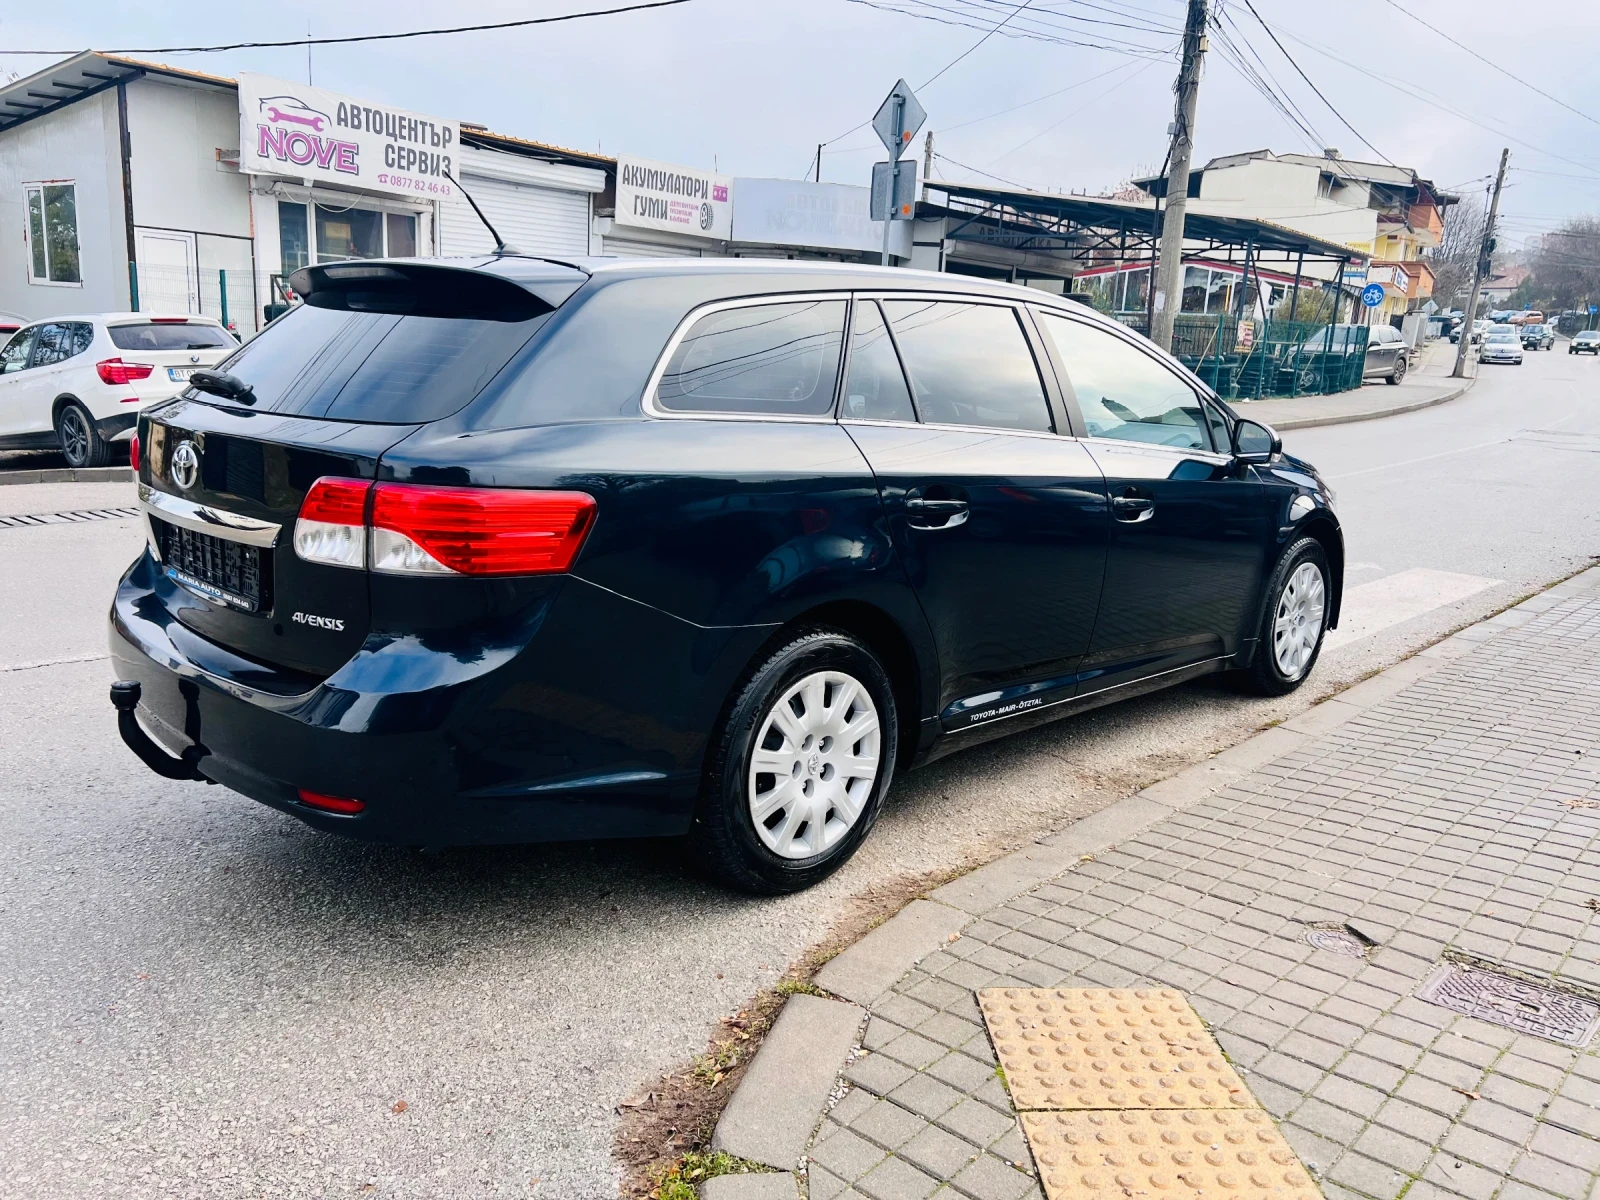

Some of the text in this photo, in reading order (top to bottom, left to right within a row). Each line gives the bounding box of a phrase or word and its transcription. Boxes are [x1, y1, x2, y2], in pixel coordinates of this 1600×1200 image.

[337, 101, 452, 149] АВТОЦЕНТЪР
[257, 124, 360, 176] NOVE
[384, 143, 452, 179] СЕРВИЗ
[390, 175, 451, 196] 0877 82 46 43
[622, 163, 709, 200] АКУМУЛАТОРИ
[633, 194, 668, 220] ГУМИ
[178, 573, 200, 588] MARIA
[201, 583, 221, 596] AUTO
[291, 611, 345, 631] AVENSIS
